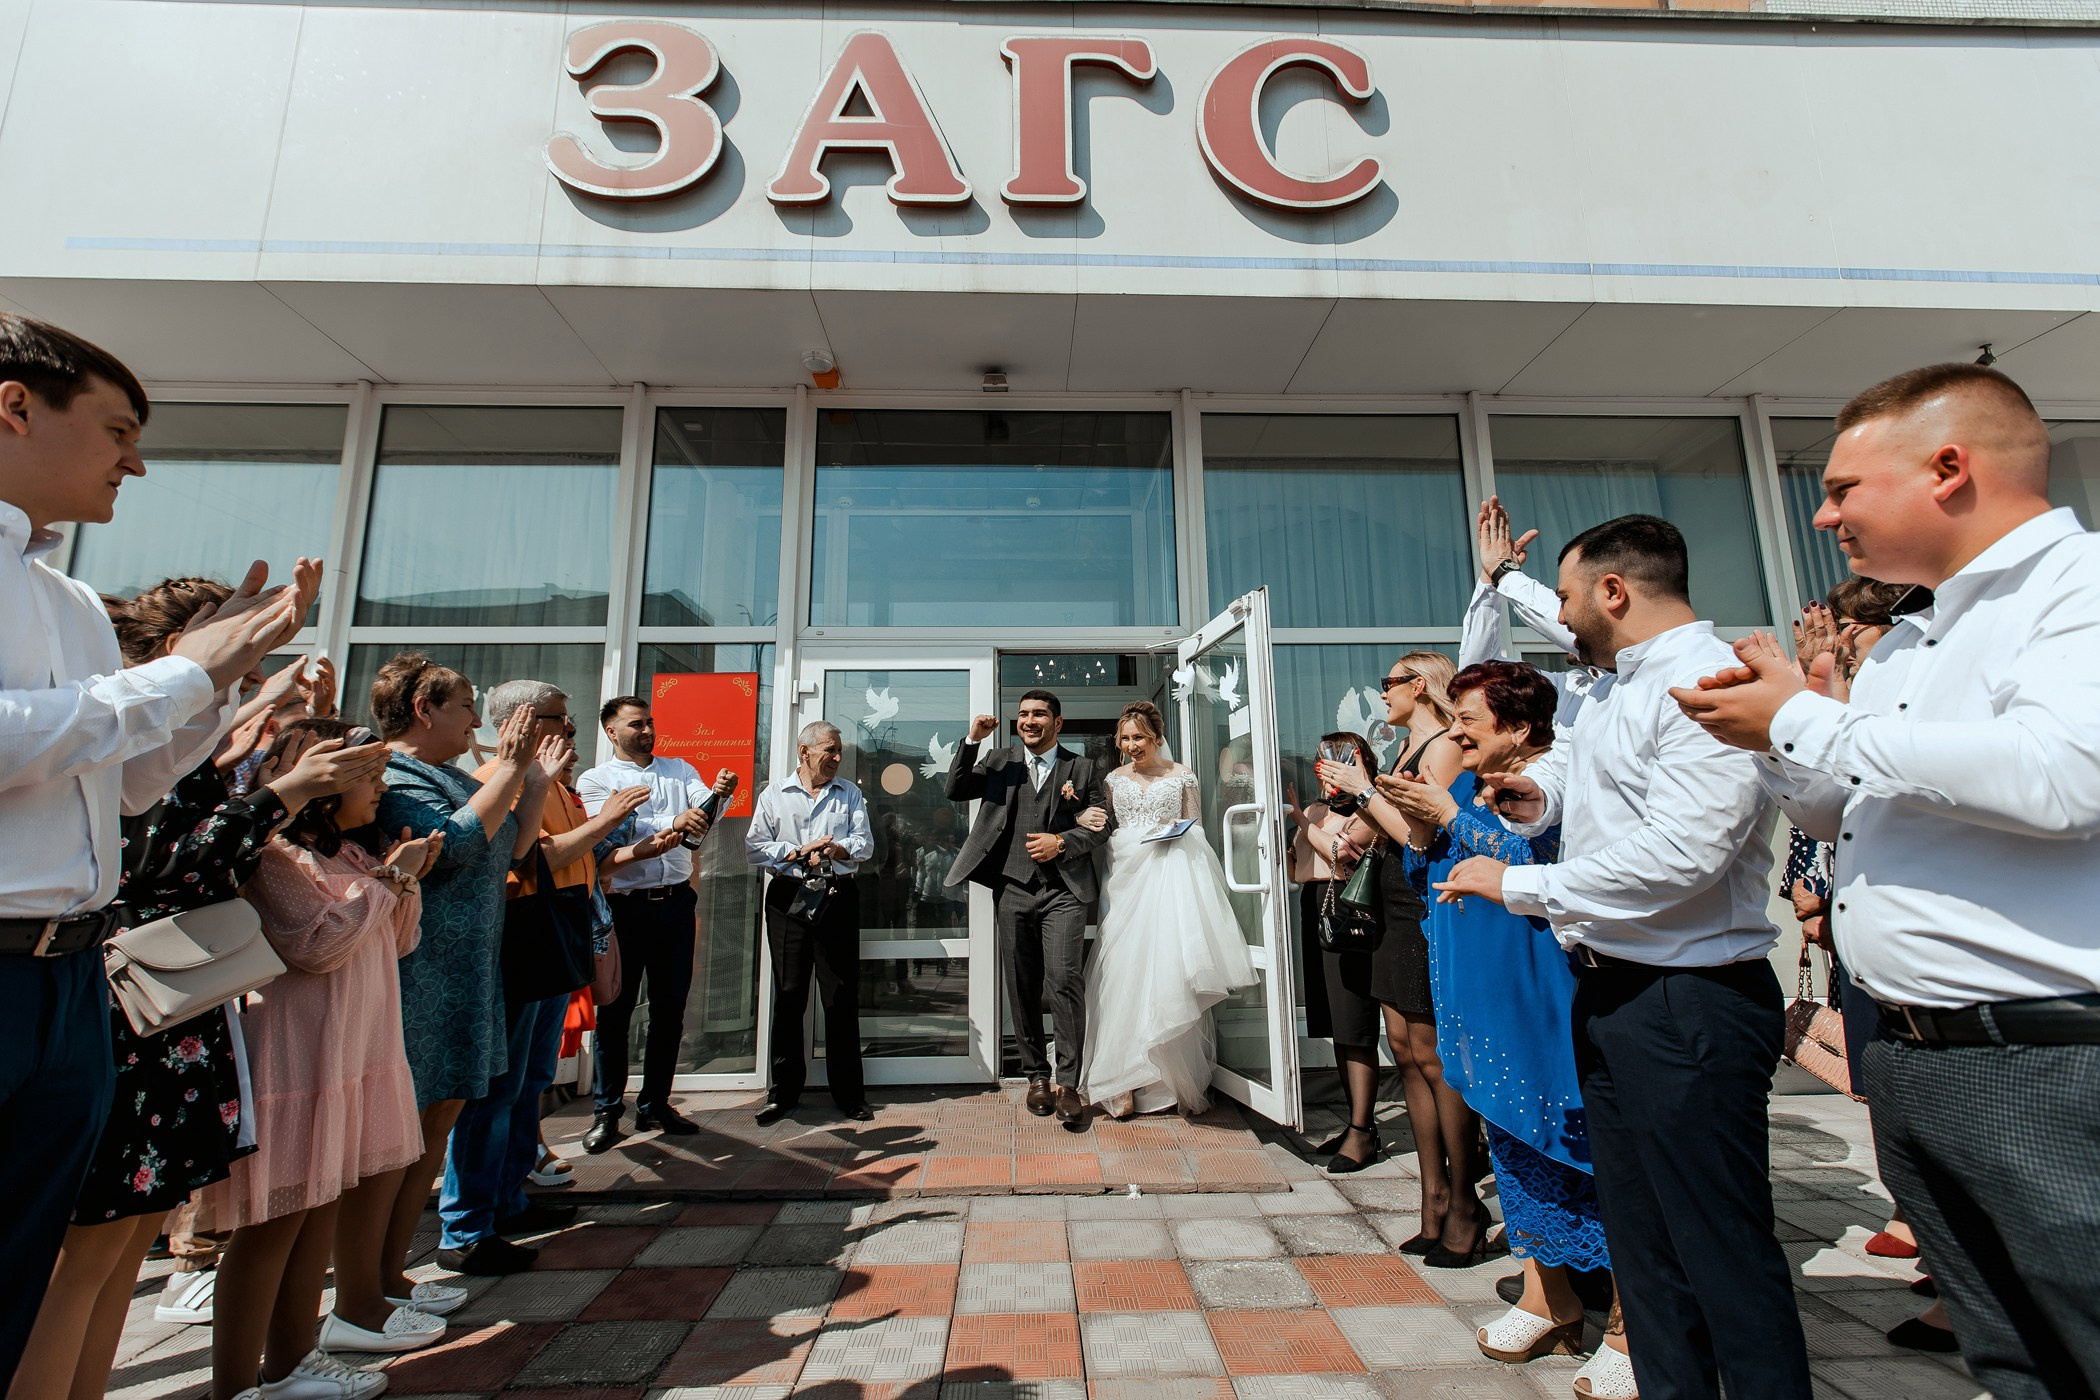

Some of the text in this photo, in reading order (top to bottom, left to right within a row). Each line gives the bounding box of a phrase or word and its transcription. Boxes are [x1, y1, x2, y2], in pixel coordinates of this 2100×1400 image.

[543, 20, 1386, 211] ЗАГС
[693, 723, 716, 736] Зал
[656, 734, 752, 752] Бракосочетания
